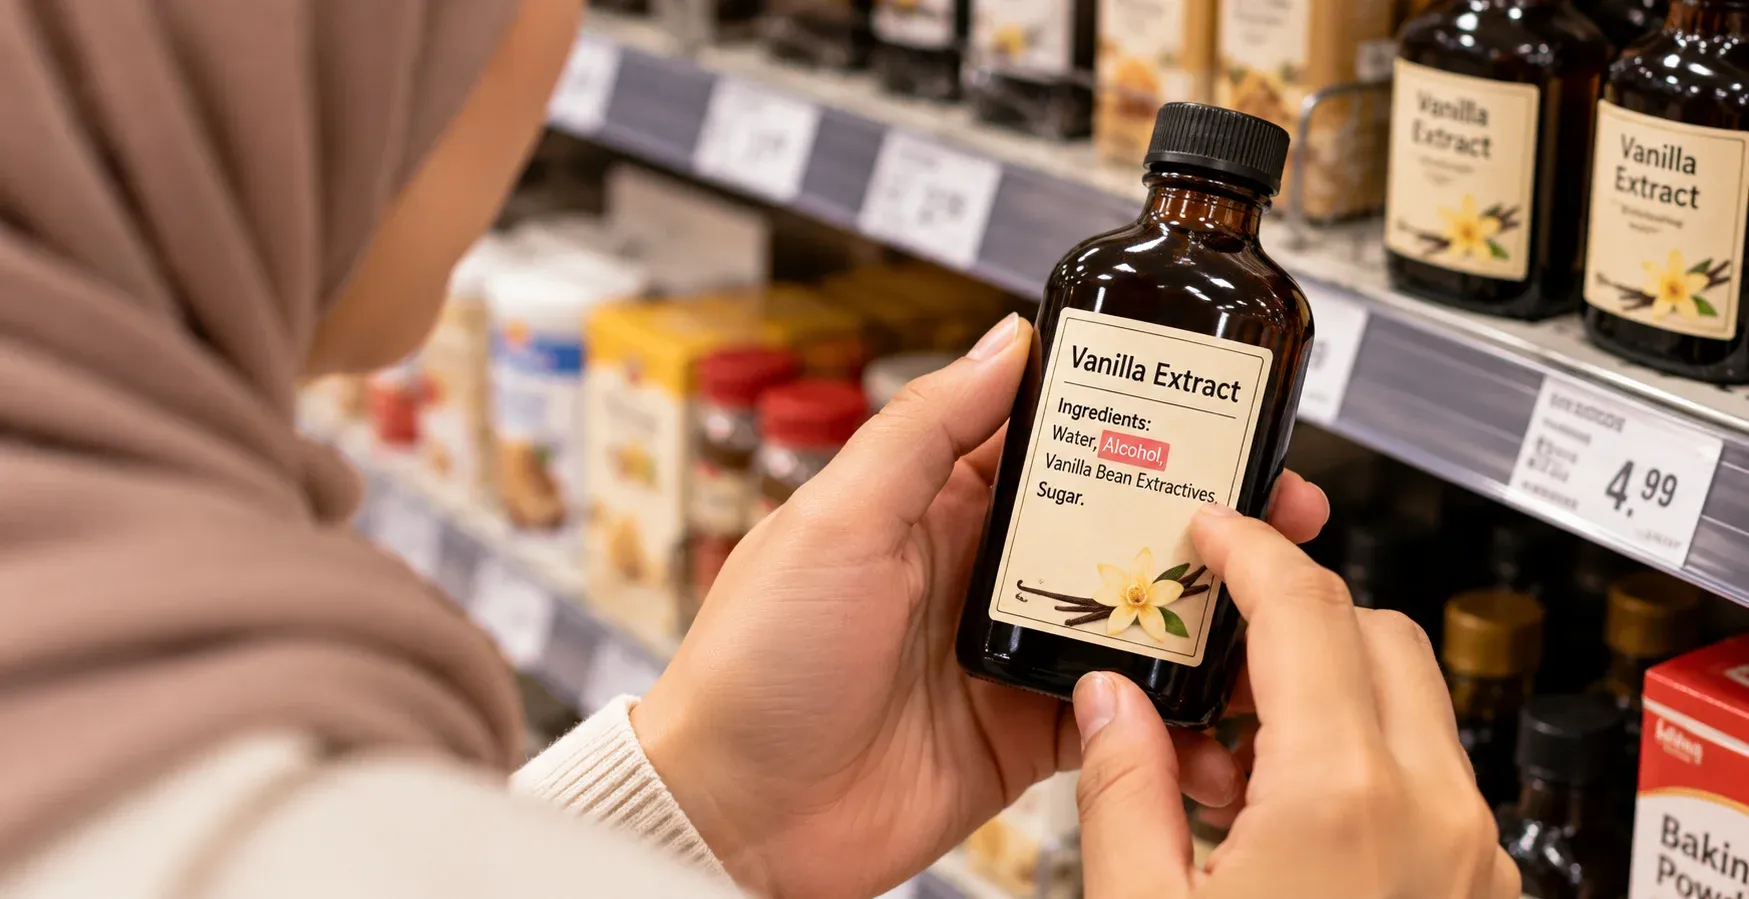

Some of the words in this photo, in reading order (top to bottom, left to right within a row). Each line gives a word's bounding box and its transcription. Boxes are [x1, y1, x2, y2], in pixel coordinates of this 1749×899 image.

[1416, 88, 1489, 127] Vanilla
[1412, 118, 1491, 159] Extract
[1620, 133, 1697, 175] Vanilla
[1615, 165, 1700, 210] Extract
[1071, 345, 1146, 383] Vanilla
[1152, 362, 1241, 403] Extract
[1057, 397, 1152, 431] Ingredients:
[1053, 424, 1097, 452] Water,
[1103, 436, 1164, 467] Alcohol,
[1046, 452, 1092, 477] Vanilla
[1095, 464, 1132, 485] Bean
[1036, 481, 1085, 506] Sugar.
